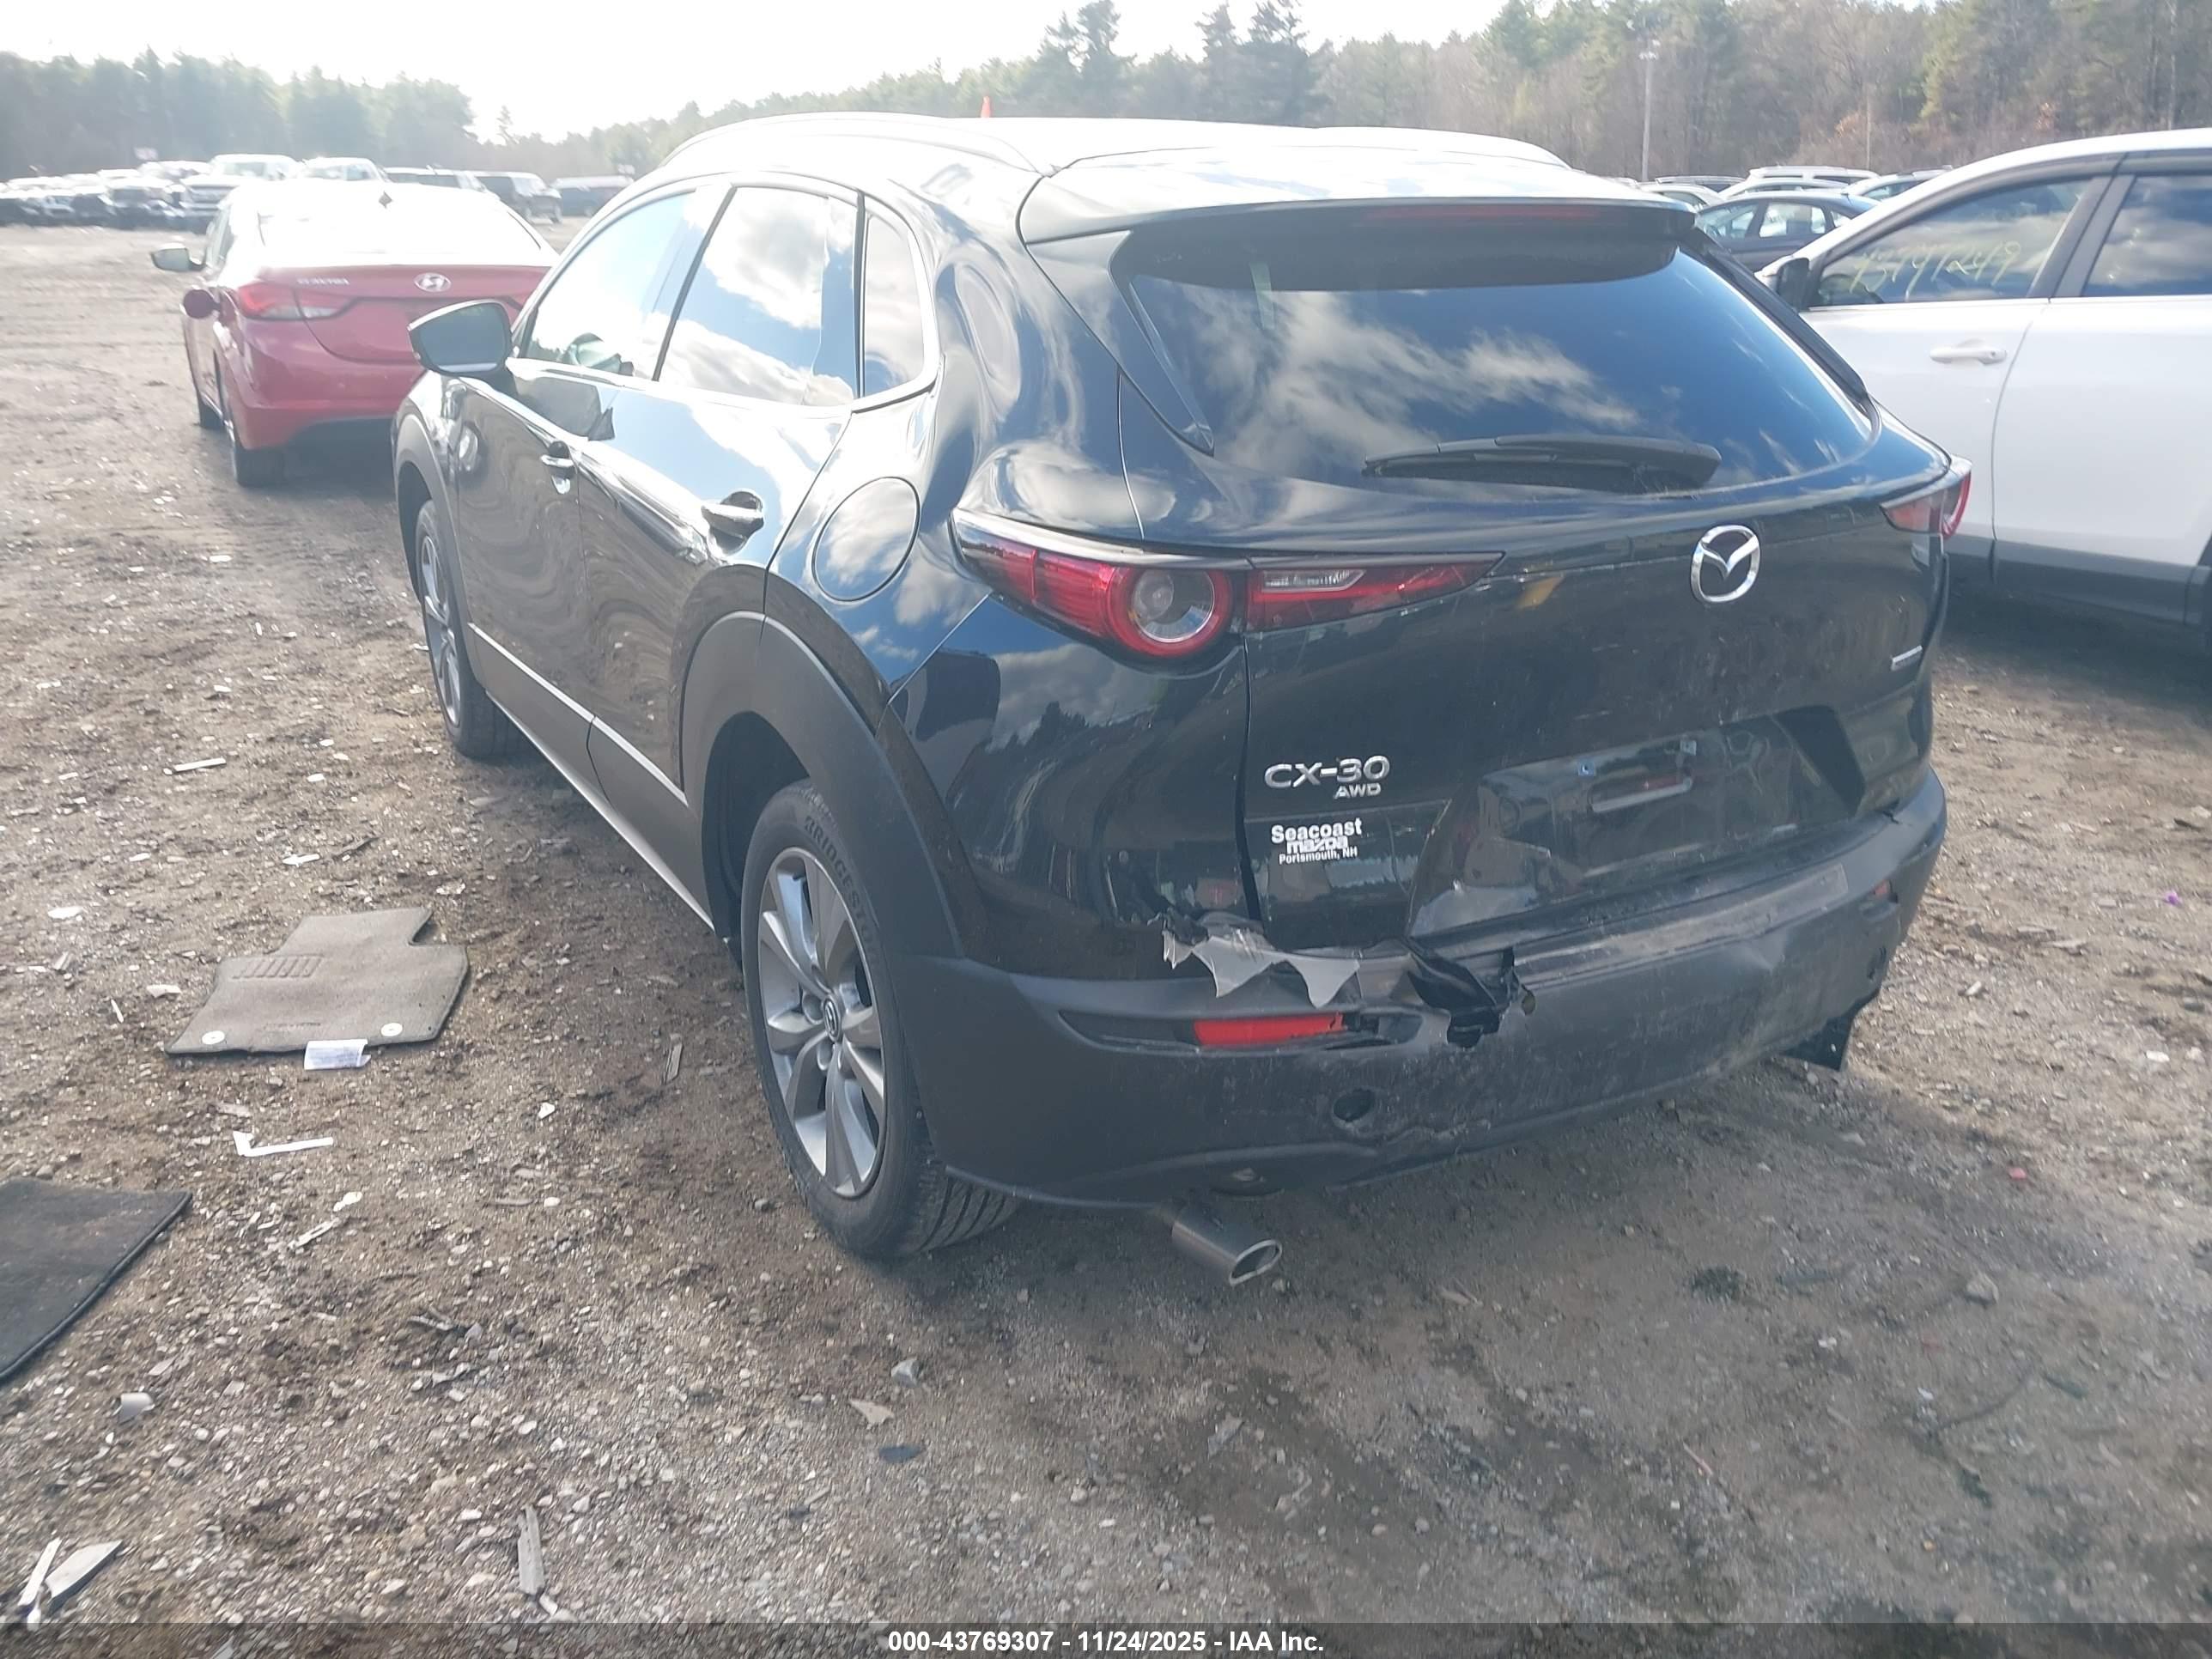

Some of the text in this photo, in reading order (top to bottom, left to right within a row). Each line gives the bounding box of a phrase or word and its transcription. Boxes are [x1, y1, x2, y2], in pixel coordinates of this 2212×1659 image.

[1264, 755, 1391, 789] CX-30
[1334, 782, 1382, 799] AWD
[1271, 817, 1363, 844] Seacoast
[1279, 846, 1358, 865] Portsmouth, NH
